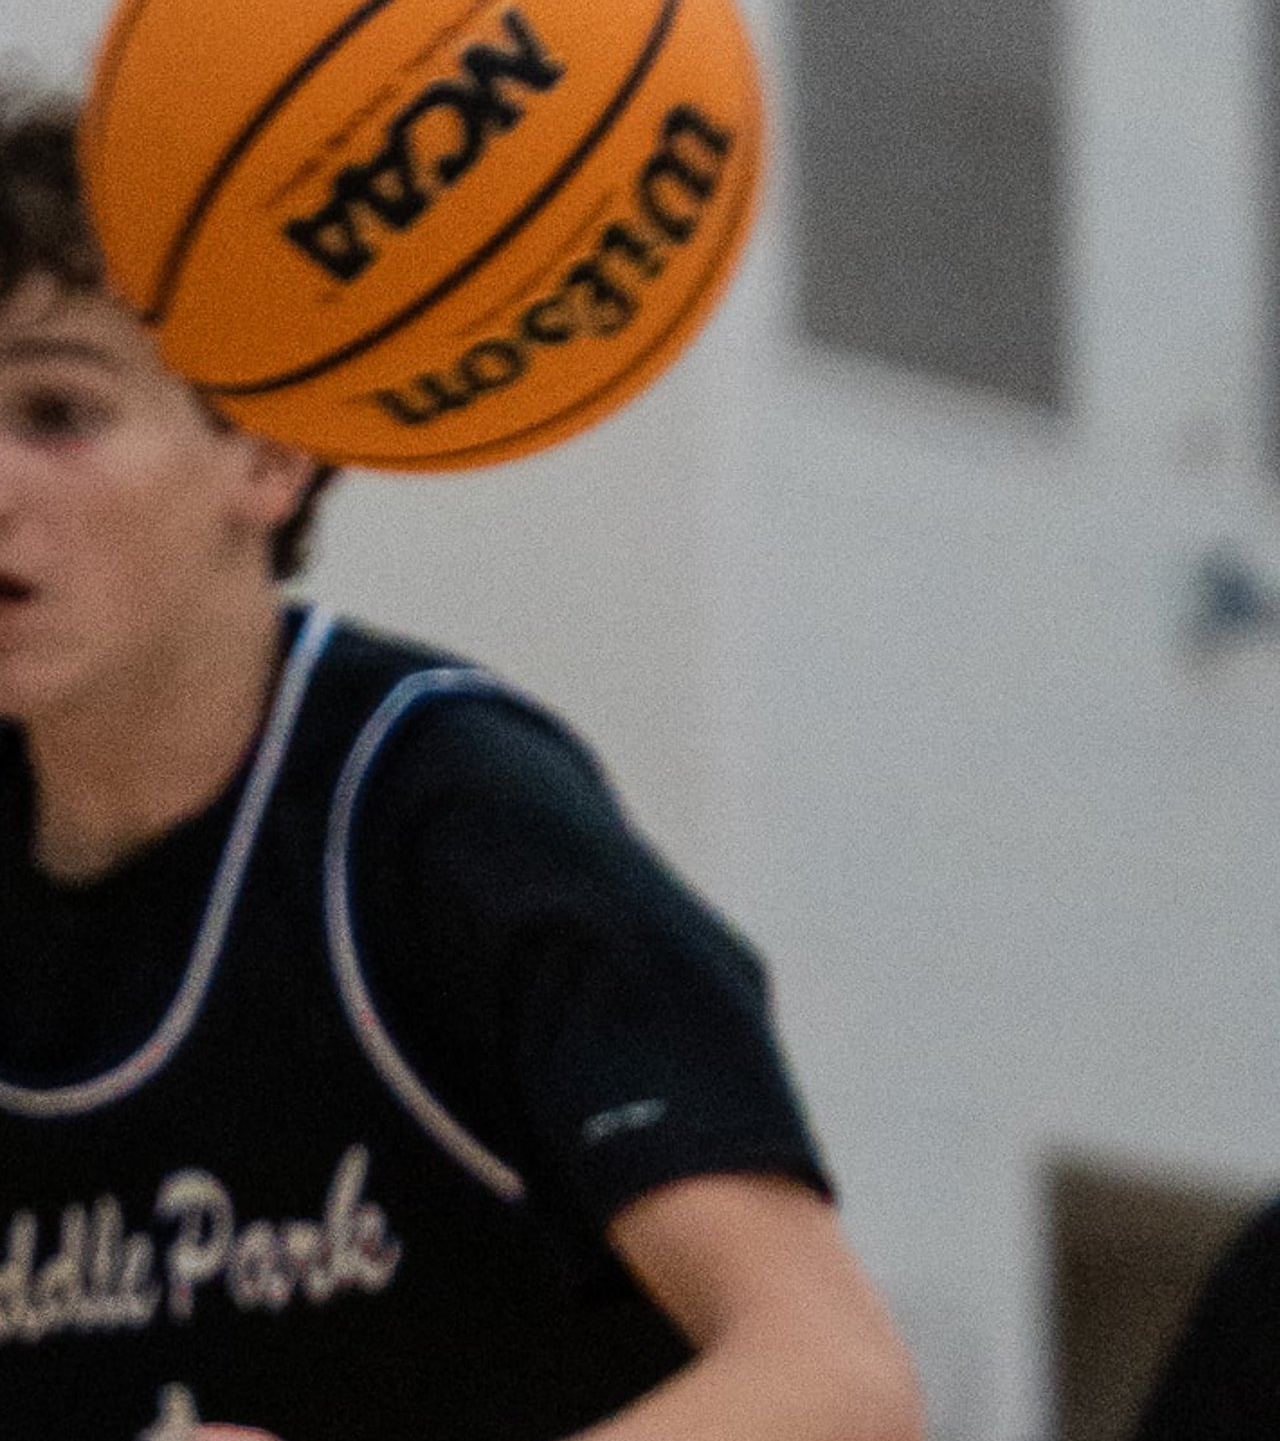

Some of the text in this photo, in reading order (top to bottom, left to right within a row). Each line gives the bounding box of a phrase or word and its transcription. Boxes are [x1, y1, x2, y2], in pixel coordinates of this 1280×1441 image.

[280, 3, 568, 283] NCAA
[373, 101, 734, 427] Wilson
[152, 1143, 404, 1324] Park
